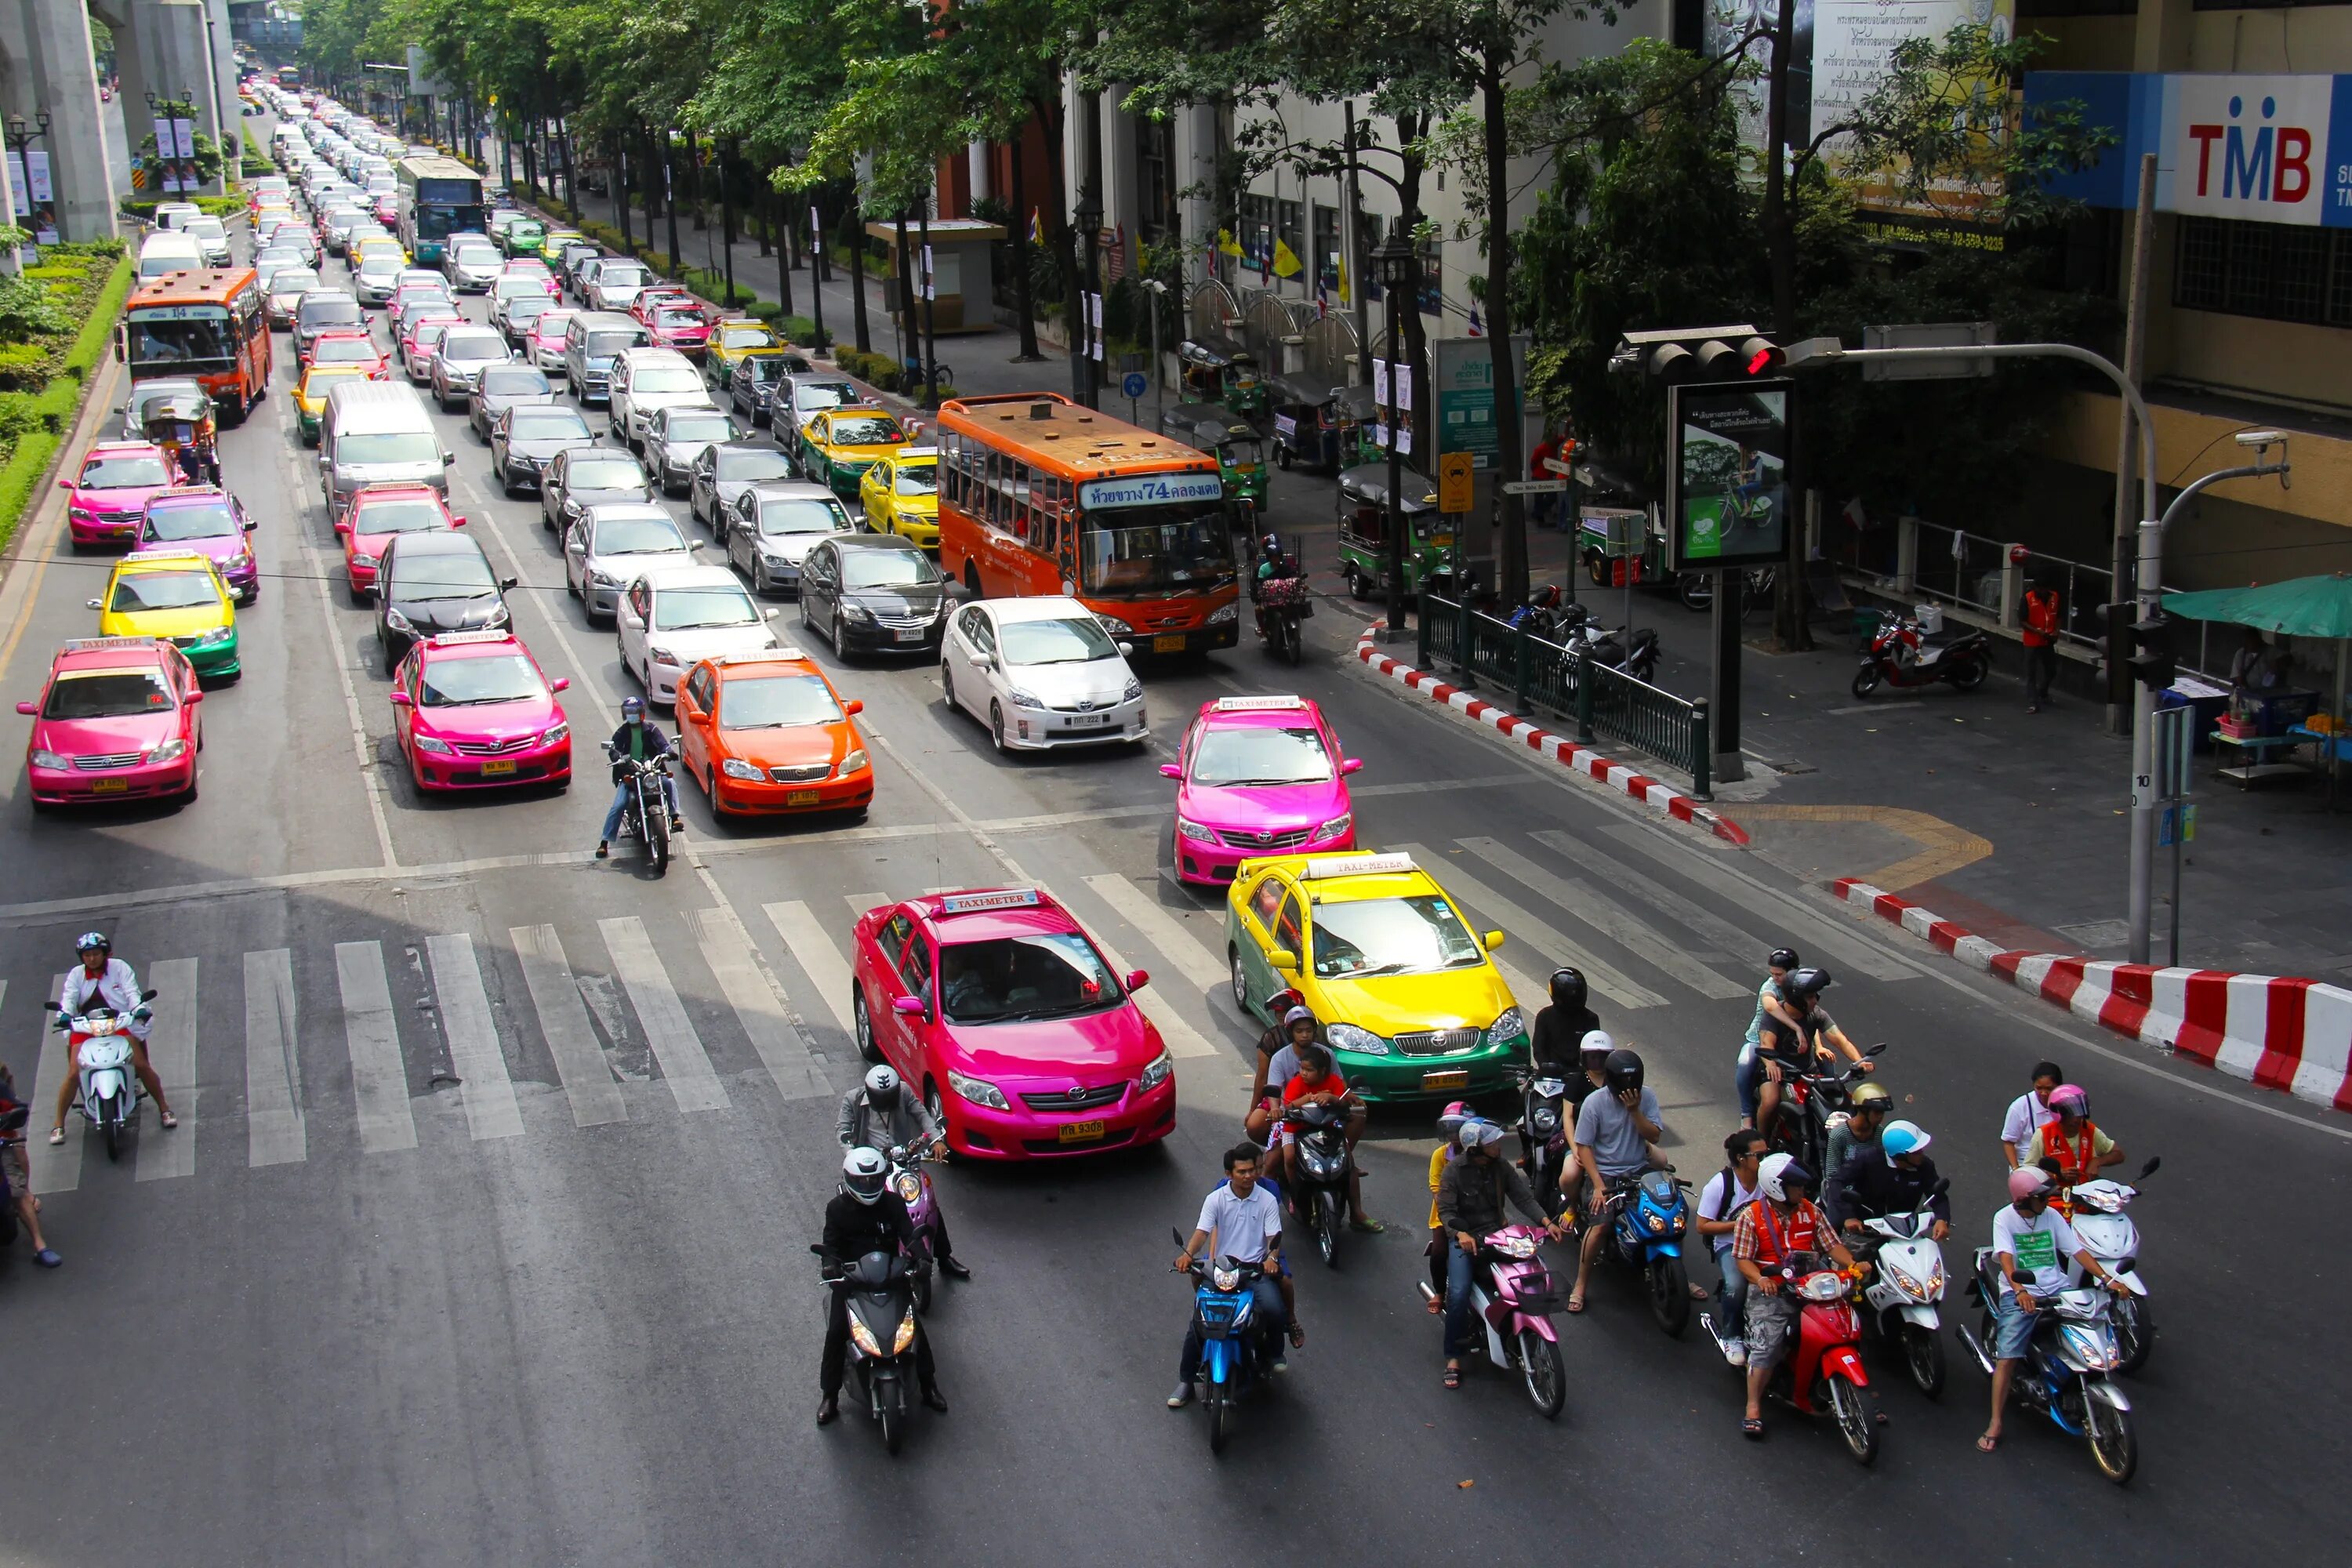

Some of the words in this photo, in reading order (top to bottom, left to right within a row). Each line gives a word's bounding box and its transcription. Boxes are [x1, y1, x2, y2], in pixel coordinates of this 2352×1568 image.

[2189, 125, 2311, 204] TMB
[172, 308, 187, 317] 14
[1091, 488, 1143, 504] ห้วยขวาง
[1142, 481, 1171, 500] 74
[1171, 483, 1220, 498] คลองเตย
[2136, 775, 2150, 788] 10
[1336, 860, 1404, 873] TAXI-METER
[957, 895, 1025, 908] TAXI-METER
[1078, 1121, 1102, 1134] 9308
[1796, 1211, 1812, 1224] 14
